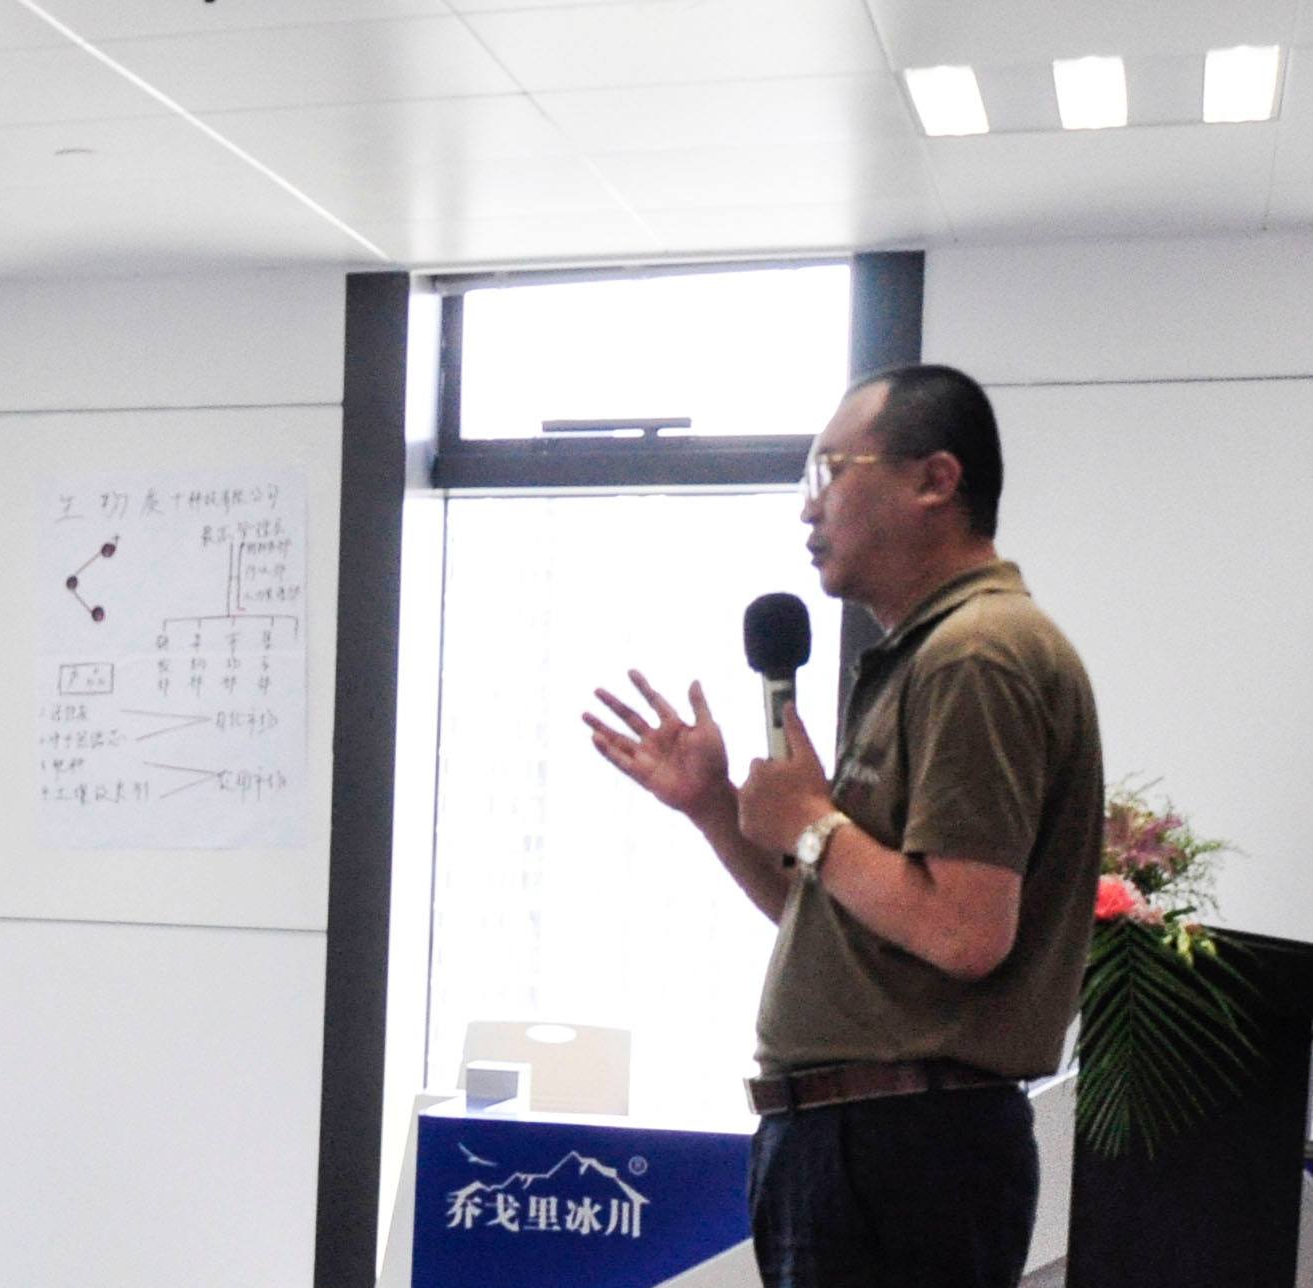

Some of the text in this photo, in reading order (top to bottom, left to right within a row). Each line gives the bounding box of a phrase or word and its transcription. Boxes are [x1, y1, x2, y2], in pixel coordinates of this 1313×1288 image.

[446, 1184, 643, 1238] 乔戈里冰川
